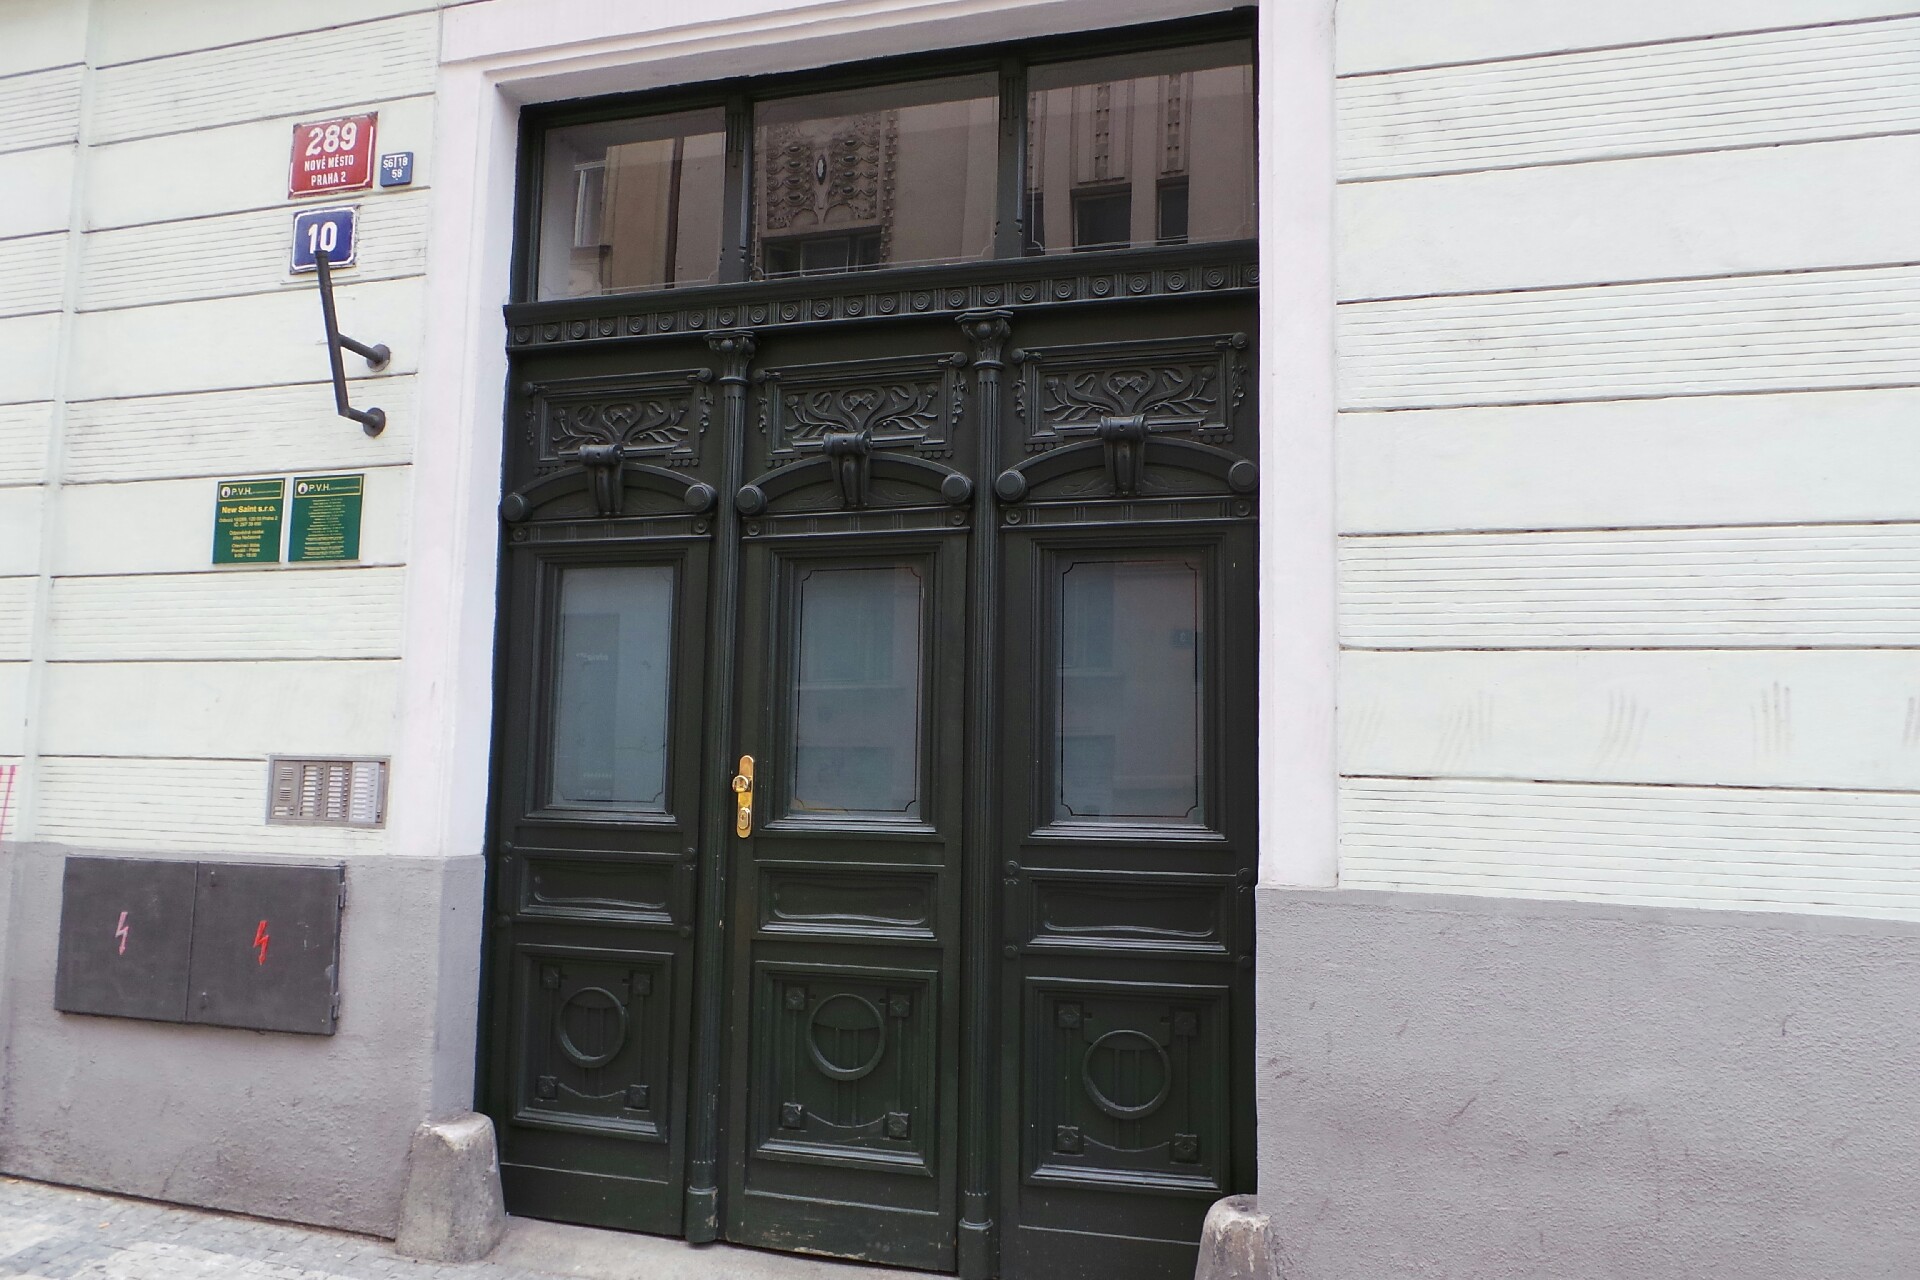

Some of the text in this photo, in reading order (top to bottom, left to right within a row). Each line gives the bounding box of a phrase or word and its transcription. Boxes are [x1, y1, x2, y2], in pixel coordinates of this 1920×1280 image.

[305, 122, 357, 156] 289
[304, 155, 326, 171] NOVÉ
[311, 171, 346, 186] PRAHA 2
[308, 221, 338, 254] 10
[221, 506, 237, 514] New
[238, 505, 257, 513] Saint
